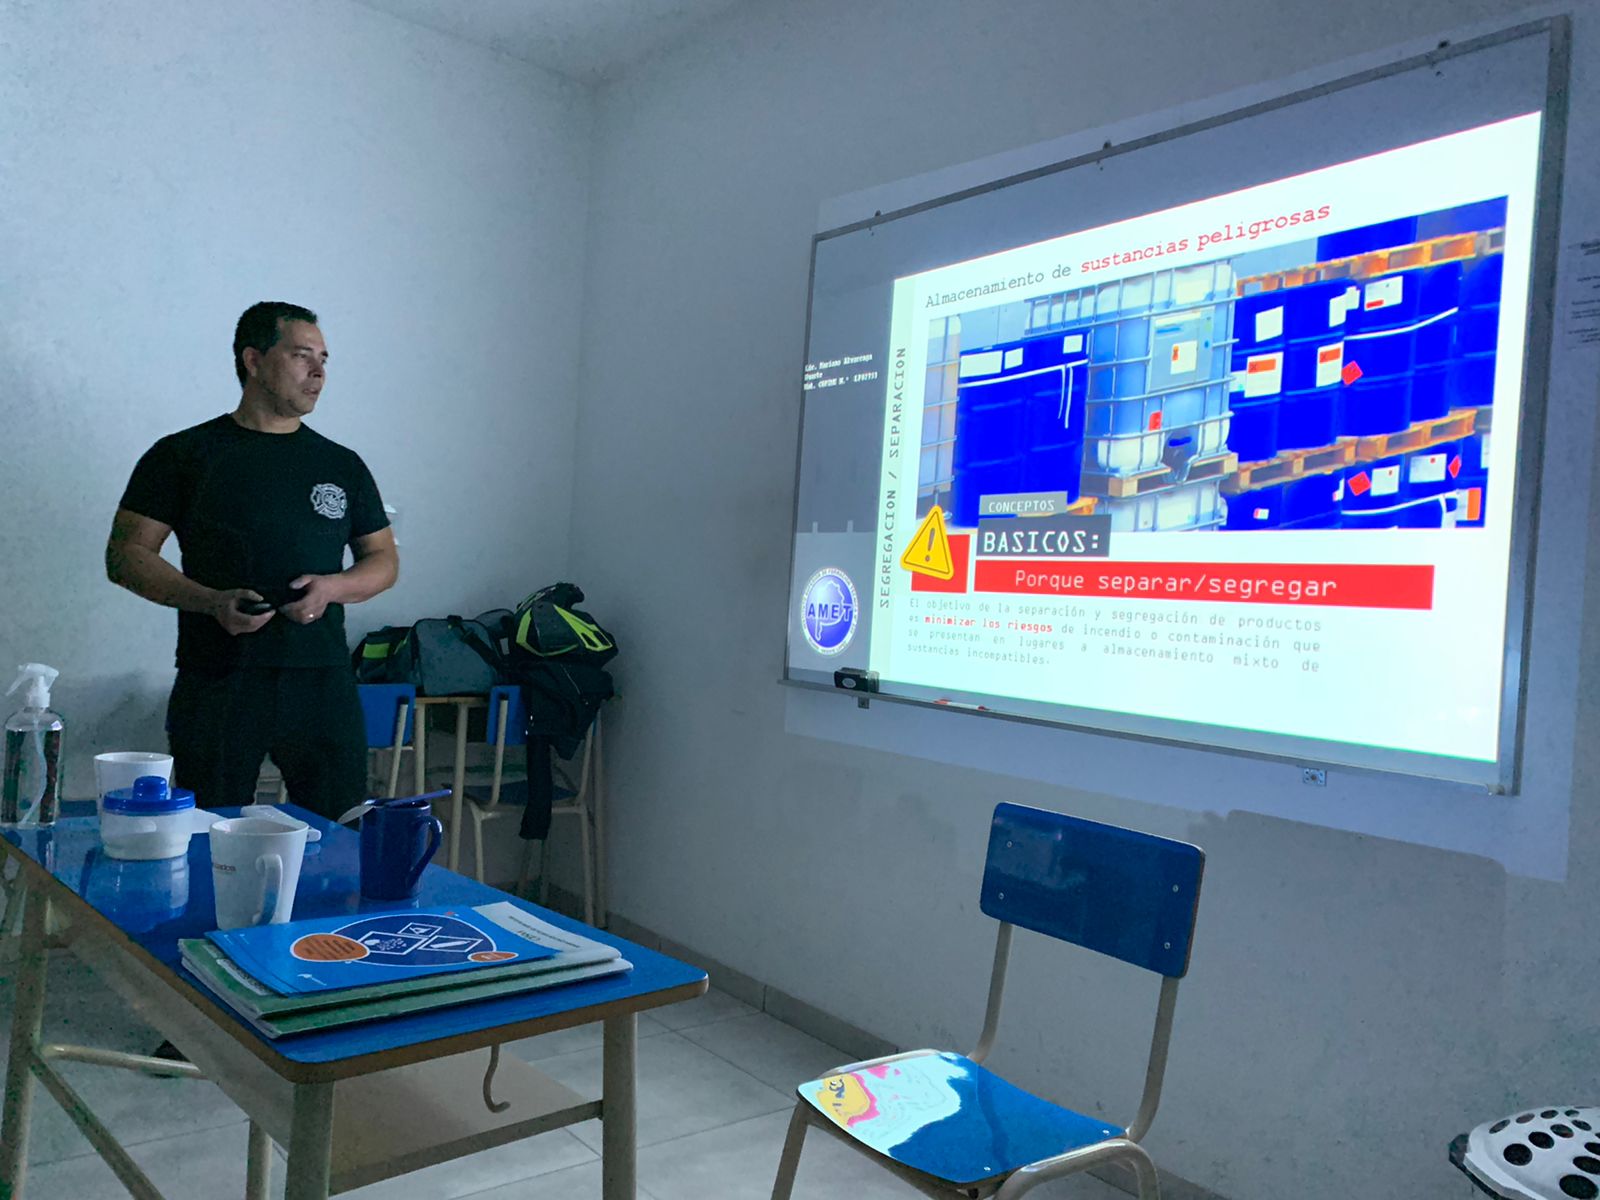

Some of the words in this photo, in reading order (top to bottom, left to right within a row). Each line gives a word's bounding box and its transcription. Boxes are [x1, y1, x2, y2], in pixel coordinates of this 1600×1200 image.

[926, 269, 1045, 308] Almacenamiento
[1052, 264, 1072, 280] de
[1081, 238, 1189, 273] sustancias
[1197, 203, 1331, 251] peligrosas
[889, 347, 906, 457] SEPARACION
[888, 471, 898, 480] /
[988, 499, 1055, 513] CONCEPTOS
[880, 489, 896, 608] SEGREGACION
[983, 530, 1100, 553] BASICOS:
[1015, 570, 1084, 590] Porque
[1098, 574, 1337, 600] separar/segregar
[808, 603, 852, 620] AMET
[909, 598, 919, 608] El
[926, 598, 971, 611] objetivo
[978, 602, 990, 613] de
[998, 602, 1010, 614] la
[1018, 604, 1085, 618] separación
[1094, 609, 1102, 620] y
[1111, 609, 1198, 625] segregación
[1209, 614, 1225, 626] de
[1238, 616, 1322, 632] productos
[924, 615, 976, 627] minimizar
[982, 618, 1000, 629] los
[1007, 620, 1053, 634] riesgos
[1061, 623, 1075, 634] de
[1083, 622, 1141, 640] incendio
[1150, 631, 1158, 640] o
[1168, 631, 1281, 650] contaminación
[1293, 639, 1321, 654] que
[907, 642, 960, 657] sustancias
[966, 647, 1051, 665] incompatibles.
[908, 629, 919, 637] se
[929, 629, 981, 643] presentan
[993, 635, 1006, 645] en
[1018, 636, 1065, 651] lugares
[1080, 643, 1088, 652] a
[1103, 643, 1214, 664] almacenamiento
[1232, 653, 1279, 670] mixto
[1301, 660, 1320, 673] de
